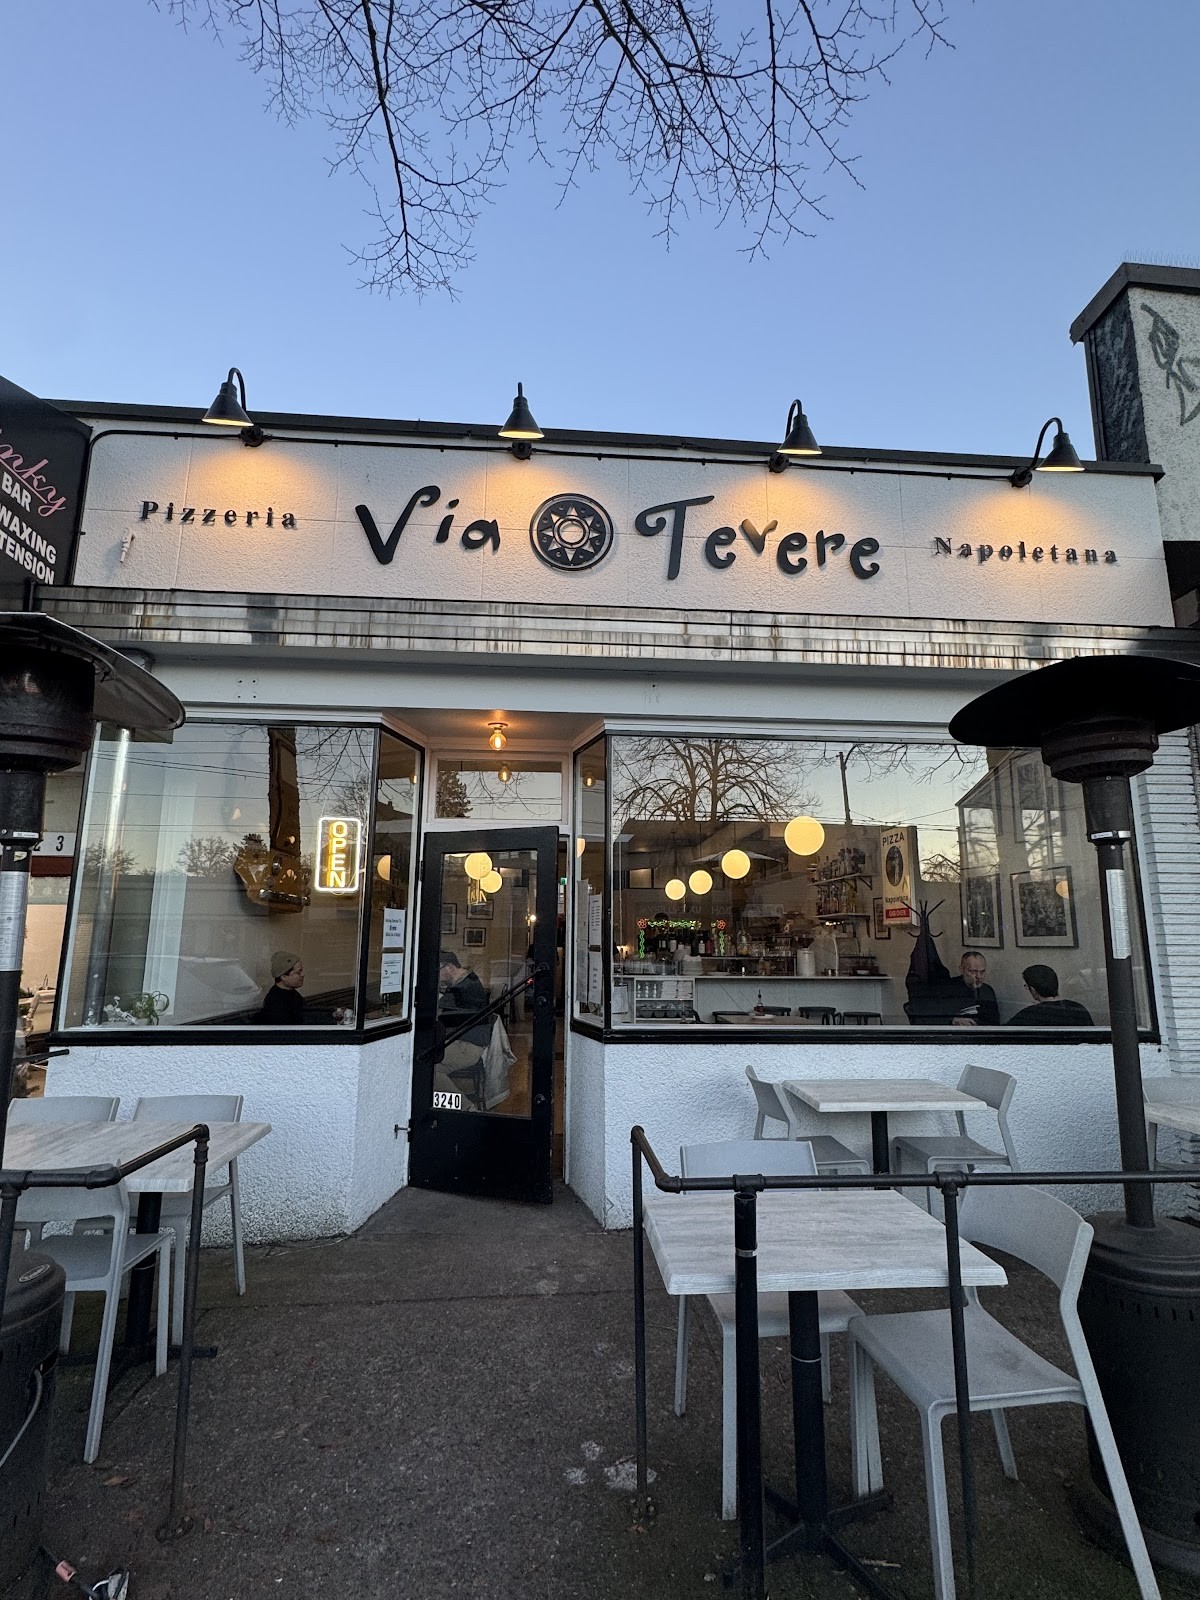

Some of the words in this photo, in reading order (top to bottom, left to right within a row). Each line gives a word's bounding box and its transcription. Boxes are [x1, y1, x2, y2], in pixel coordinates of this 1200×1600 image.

[0, 444, 66, 517] nky
[2, 471, 32, 512] BAR
[140, 499, 296, 530] Pizzeria
[355, 485, 501, 565] Via
[635, 495, 880, 580] Tevere
[934, 536, 1118, 564] Napoletana
[329, 821, 347, 888] OPEN
[882, 832, 905, 847] PIZZA
[434, 1092, 460, 1109] 3240
